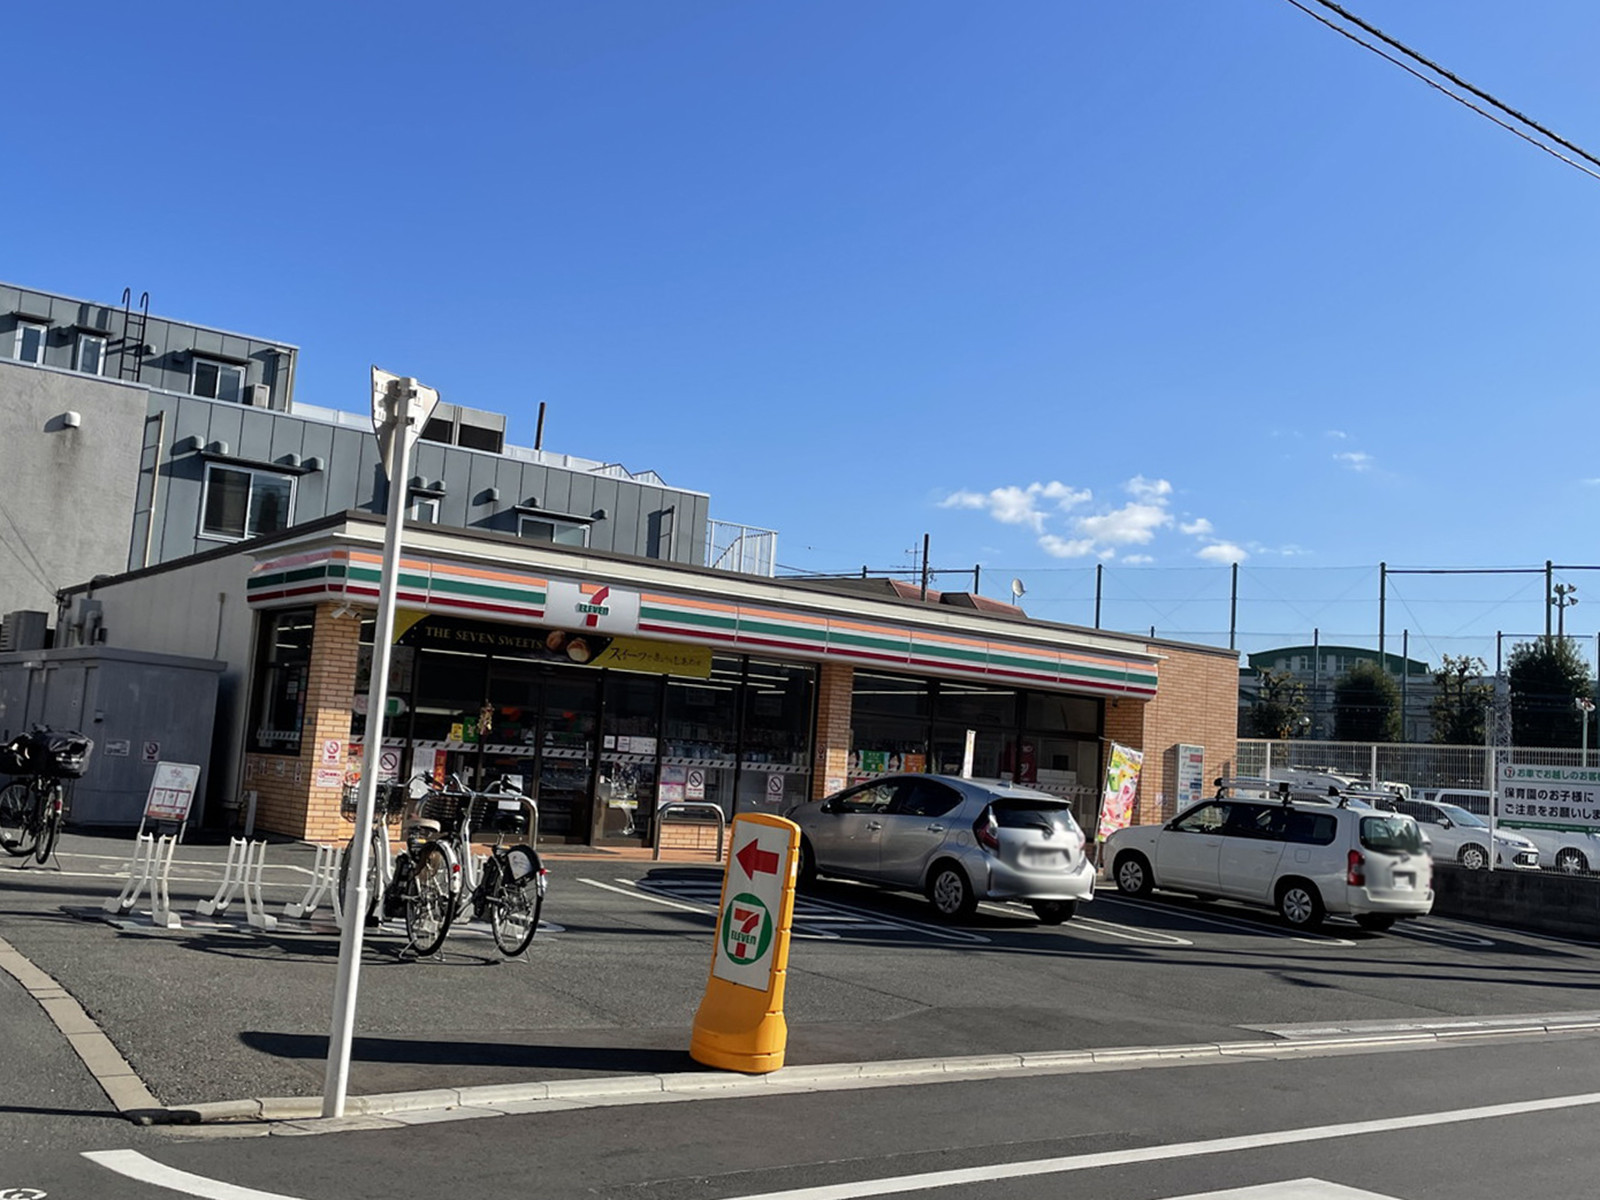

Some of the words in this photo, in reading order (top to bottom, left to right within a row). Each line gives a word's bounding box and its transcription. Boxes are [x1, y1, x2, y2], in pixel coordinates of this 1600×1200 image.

[425, 626, 452, 639] THE
[456, 630, 496, 644] SEVEN
[498, 636, 544, 650] SWEETS
[1505, 787, 1594, 803] 保育園のお子様に
